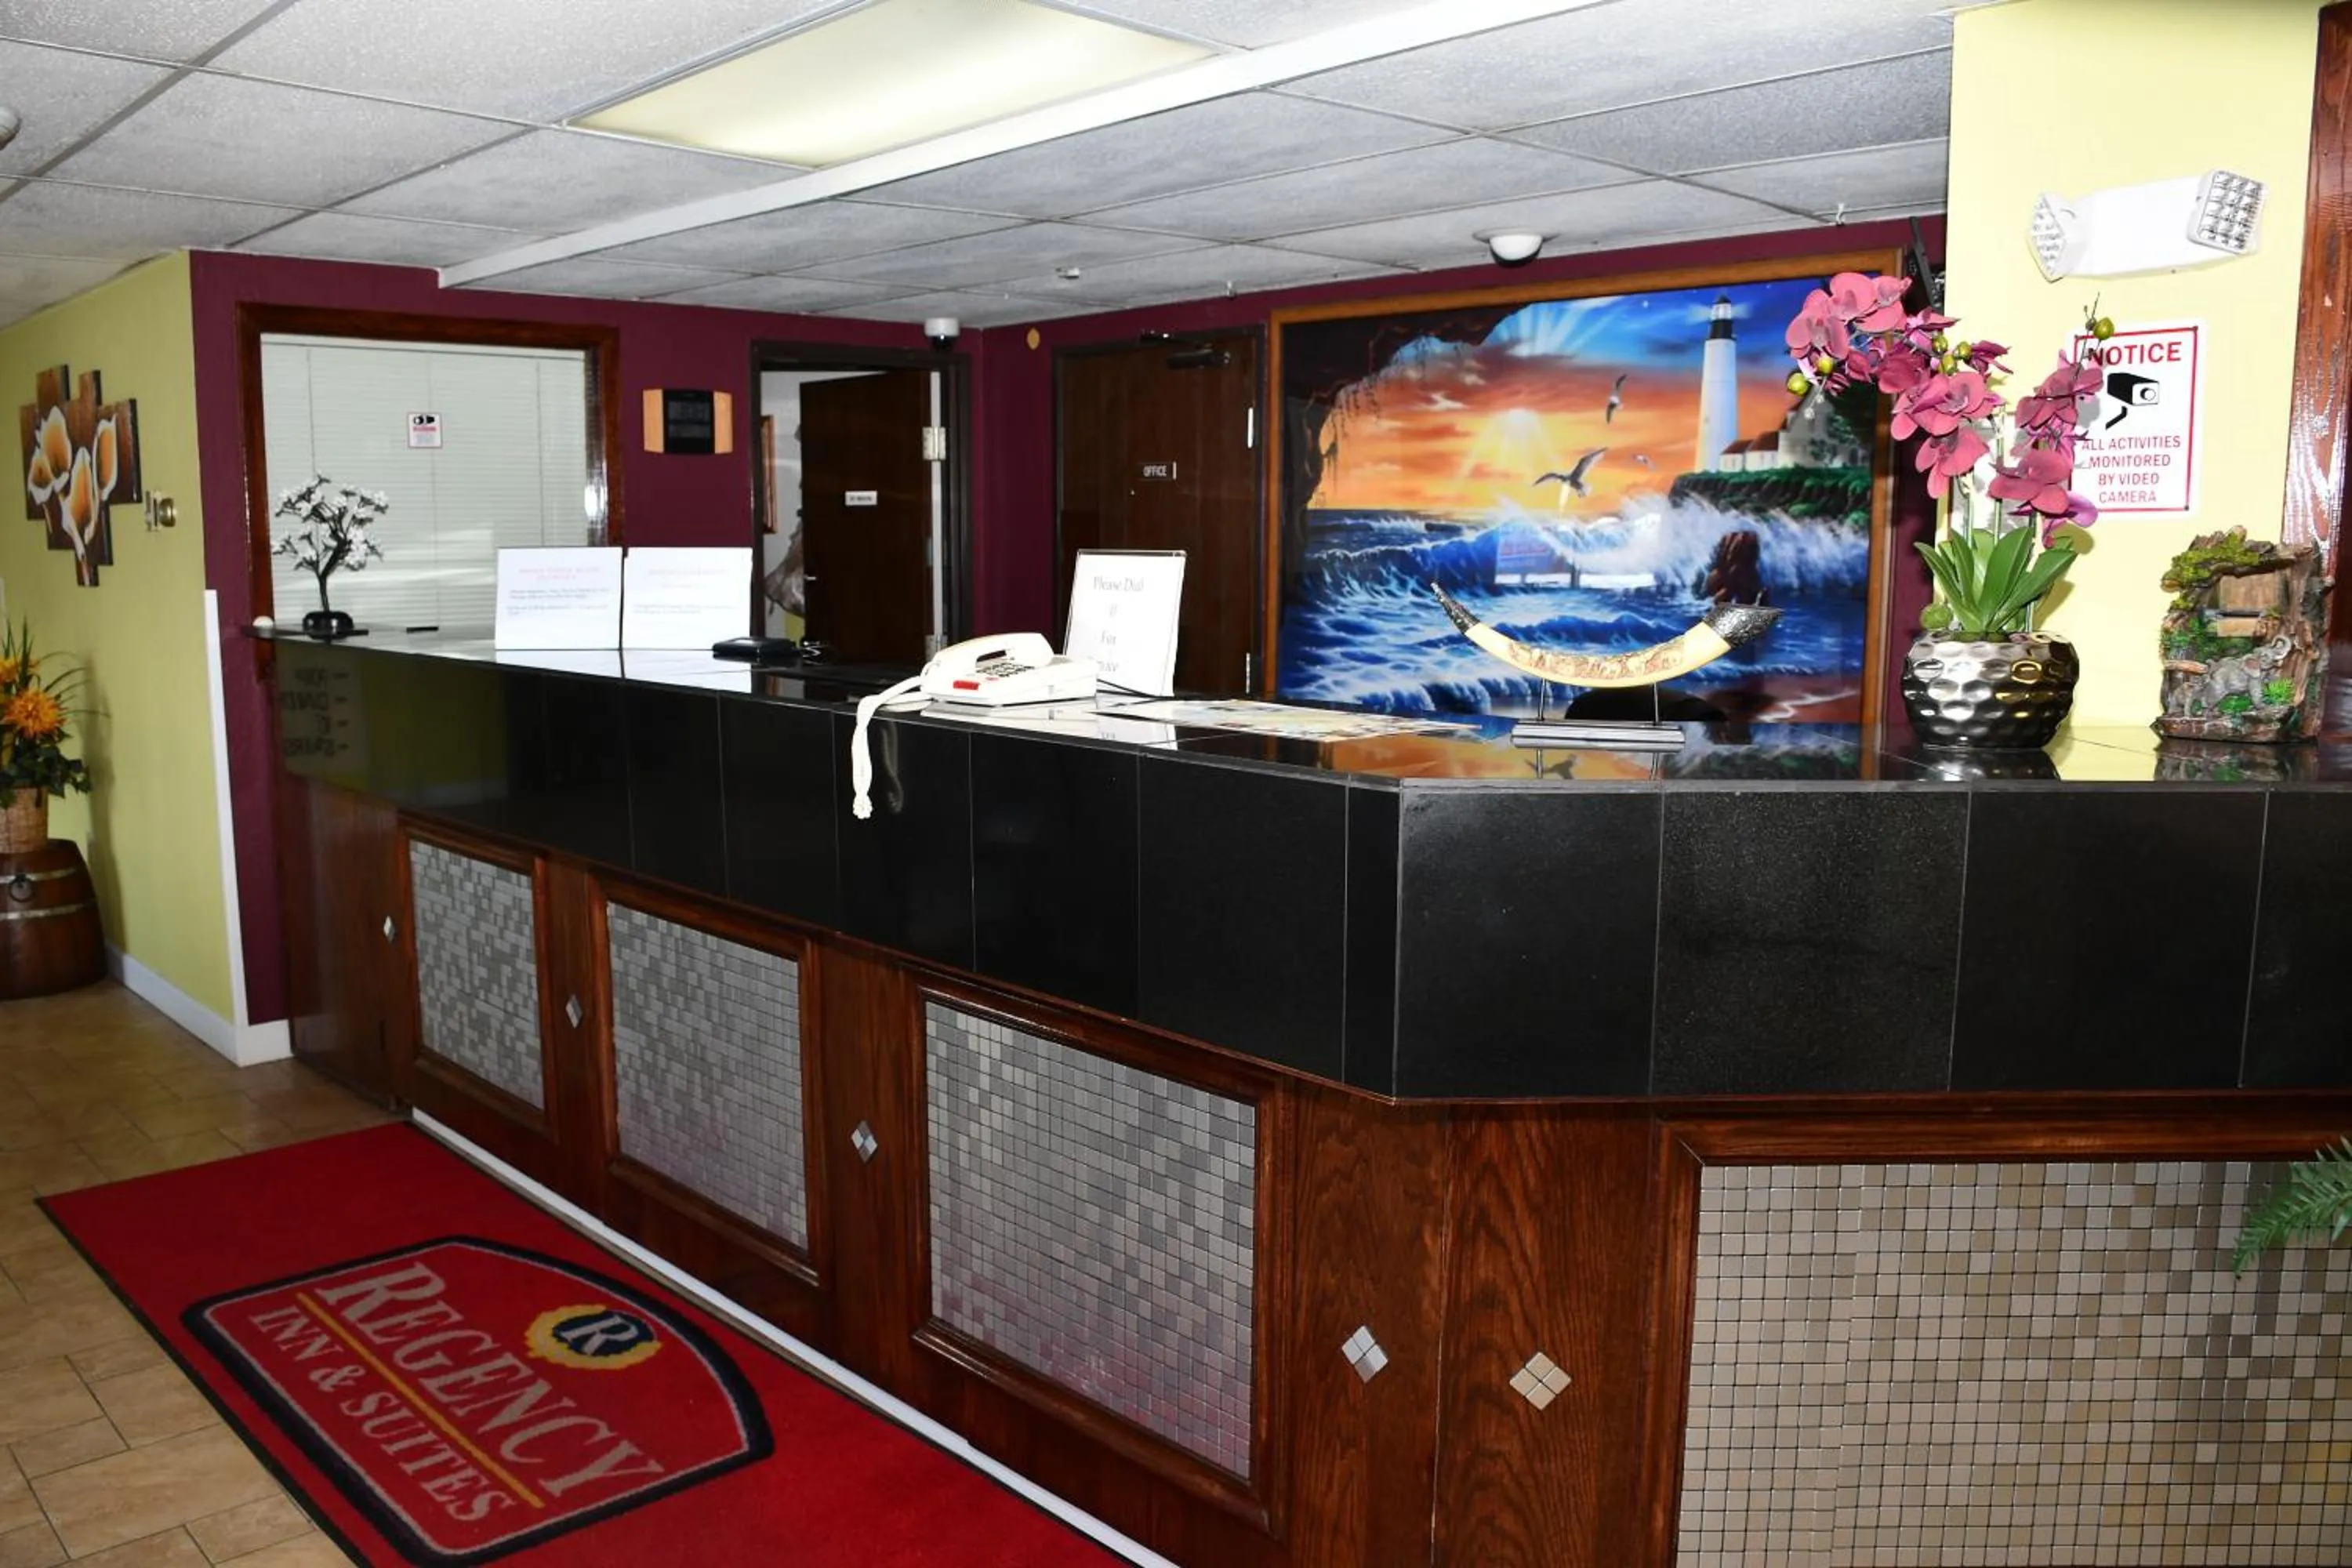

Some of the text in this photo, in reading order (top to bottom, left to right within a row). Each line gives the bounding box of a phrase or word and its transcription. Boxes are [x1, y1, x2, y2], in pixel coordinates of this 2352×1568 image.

[2087, 341, 2183, 366] NOTICE
[2082, 435, 2181, 451] ALL ACTIVITIES
[2089, 454, 2171, 468] MONITORED
[2098, 472, 2160, 486] BY VIDEO
[2099, 490, 2158, 504] CAMERA
[560, 1314, 639, 1356] R
[315, 1261, 665, 1497] REGENCY
[248, 1305, 517, 1522] INN & SUITES
